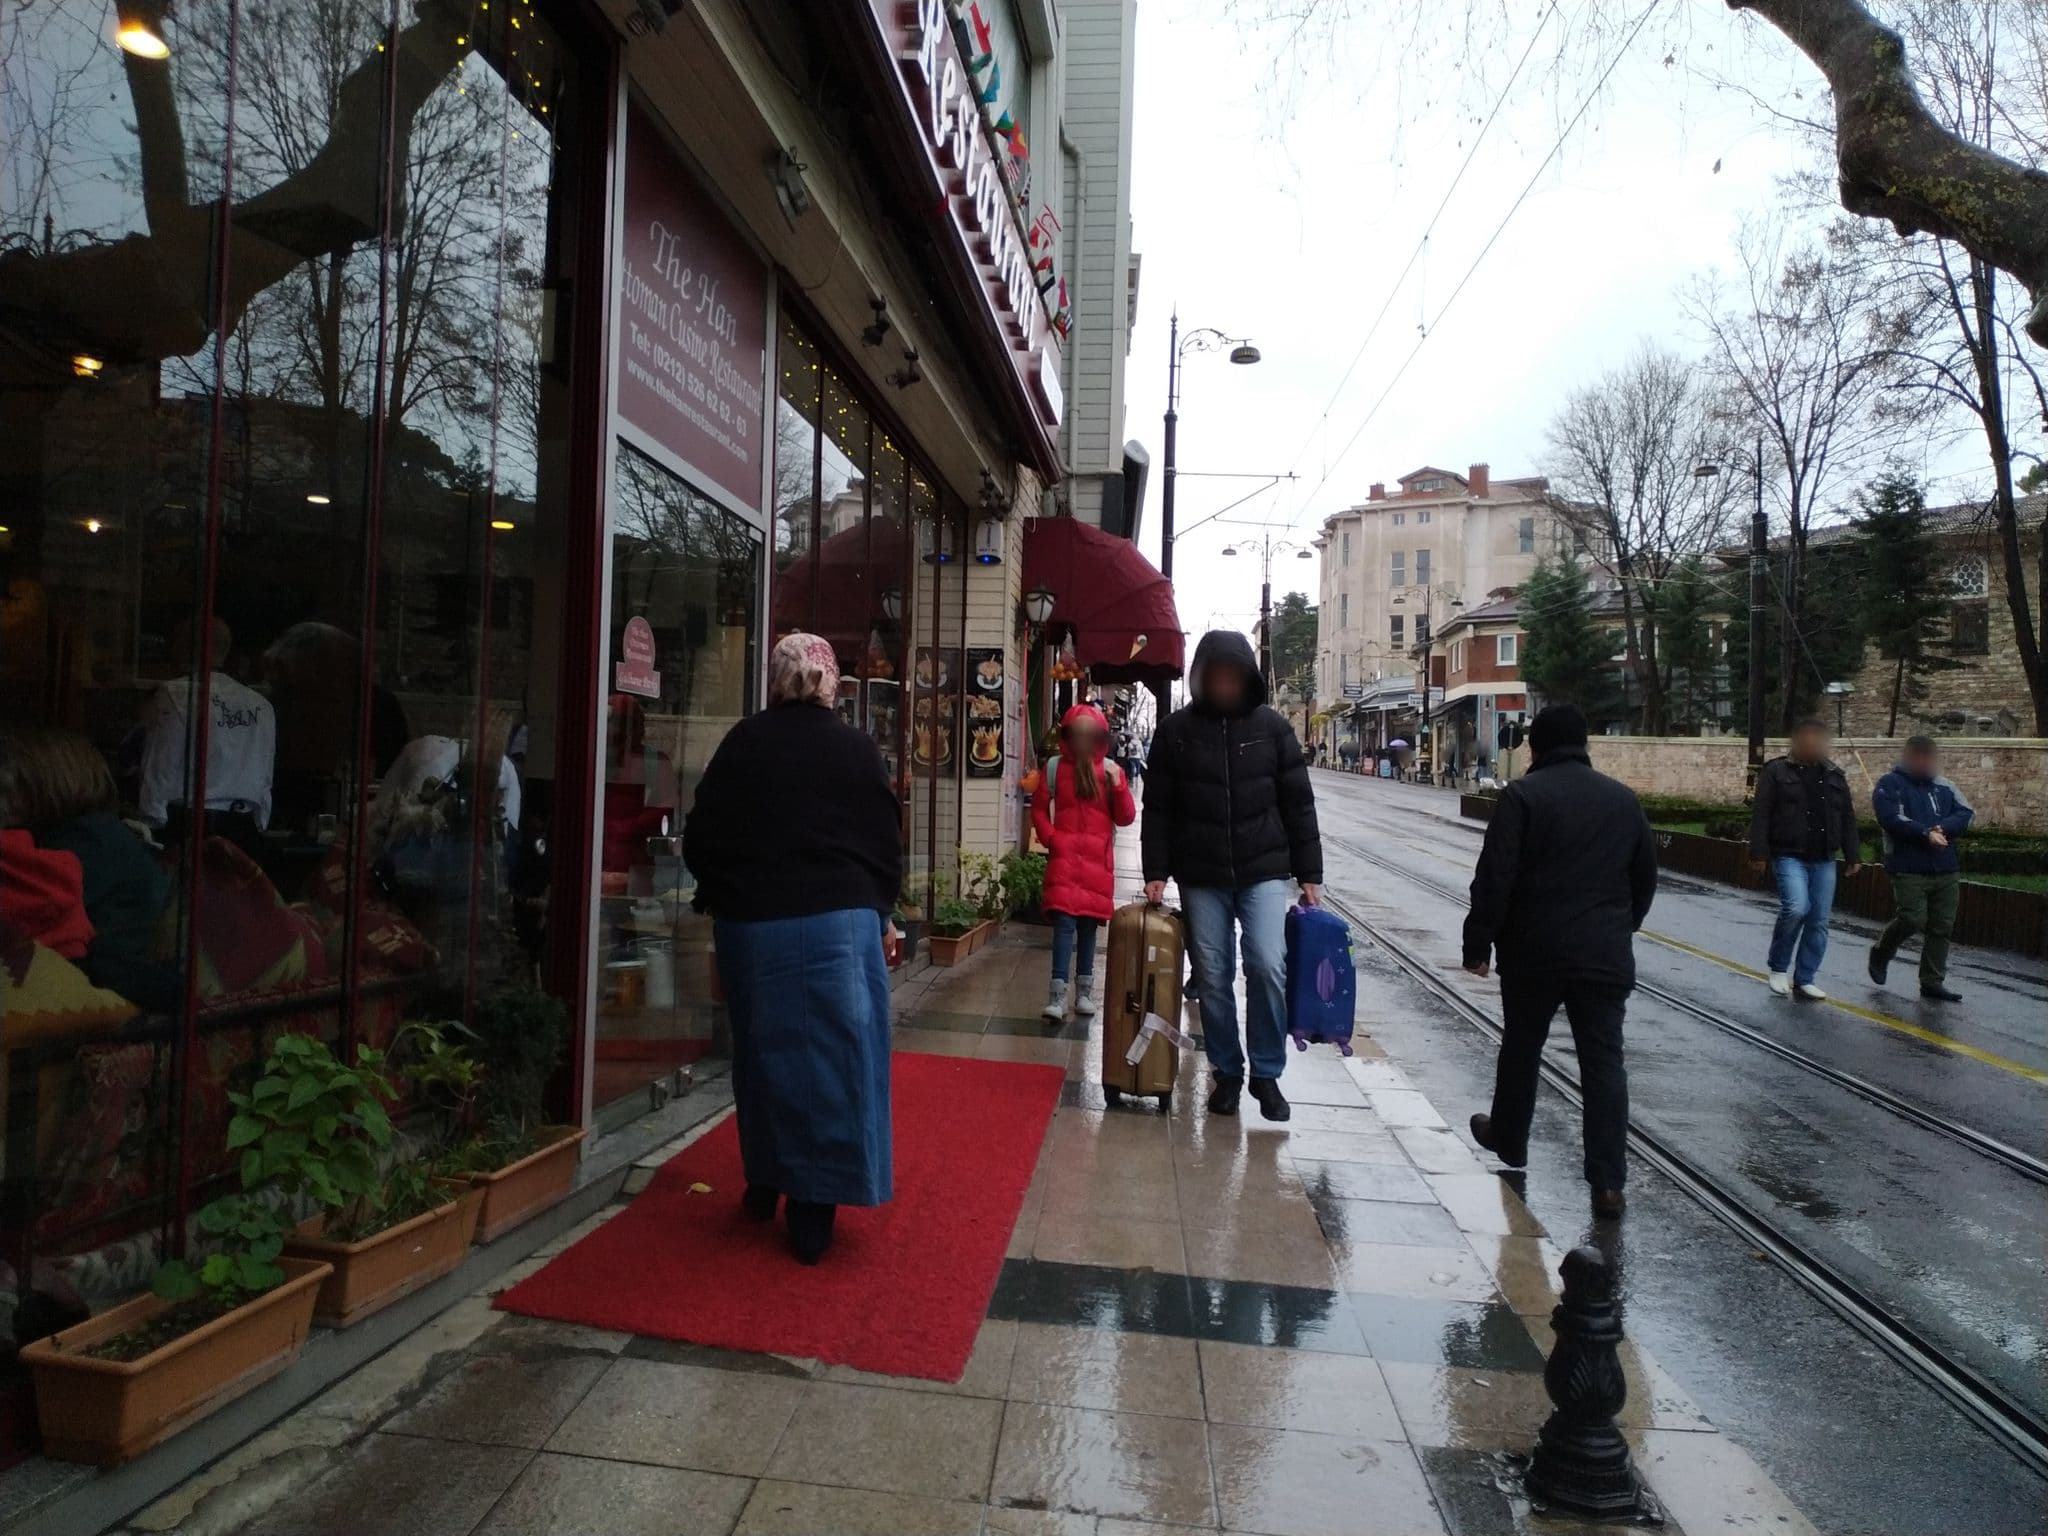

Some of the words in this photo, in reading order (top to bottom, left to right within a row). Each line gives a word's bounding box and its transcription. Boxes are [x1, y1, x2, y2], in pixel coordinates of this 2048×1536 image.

[917, 0, 1038, 353] Restaurant
[651, 221, 691, 299] The
[696, 274, 737, 347] Han
[631, 322, 650, 356] Tel:
[654, 346, 686, 391] (0212)
[688, 374, 705, 402] 526
[706, 389, 718, 413] 62
[719, 400, 730, 424] 62
[709, 340, 762, 416] Restaurant
